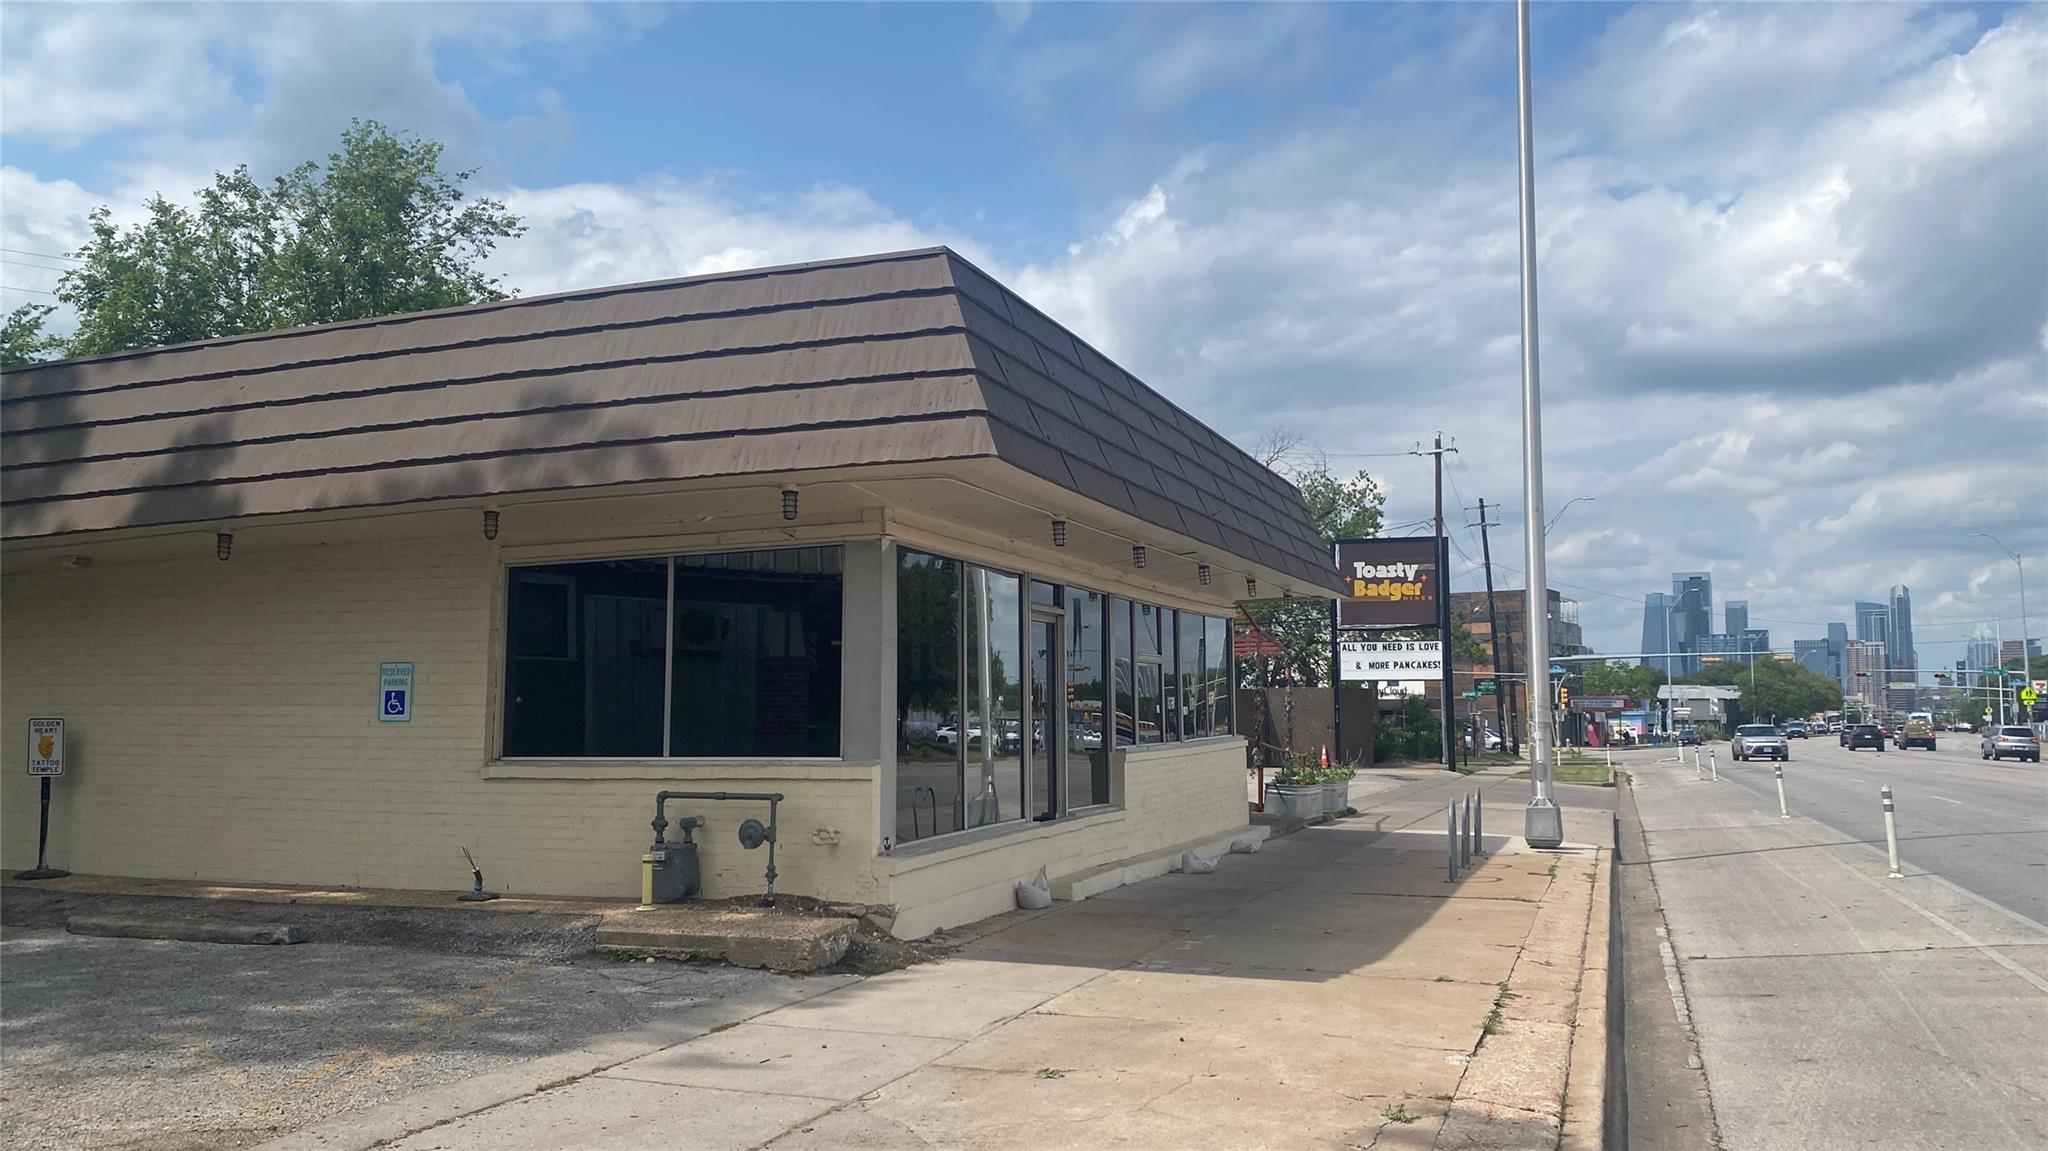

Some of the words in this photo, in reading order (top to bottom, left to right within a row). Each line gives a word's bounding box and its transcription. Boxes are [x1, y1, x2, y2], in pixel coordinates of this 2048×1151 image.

[1353, 562, 1418, 581] Toasty
[1354, 580, 1422, 601] Badger
[1342, 643, 1357, 652] ALL
[1360, 643, 1377, 651] YOU
[1382, 643, 1403, 651] NEED
[1406, 643, 1415, 651] IS
[1419, 643, 1440, 651] LOVE
[1368, 661, 1390, 670] MORE
[1393, 661, 1441, 669] PANCAKES!
[382, 668, 411, 676] RESERVED
[383, 678, 408, 687] PARKING
